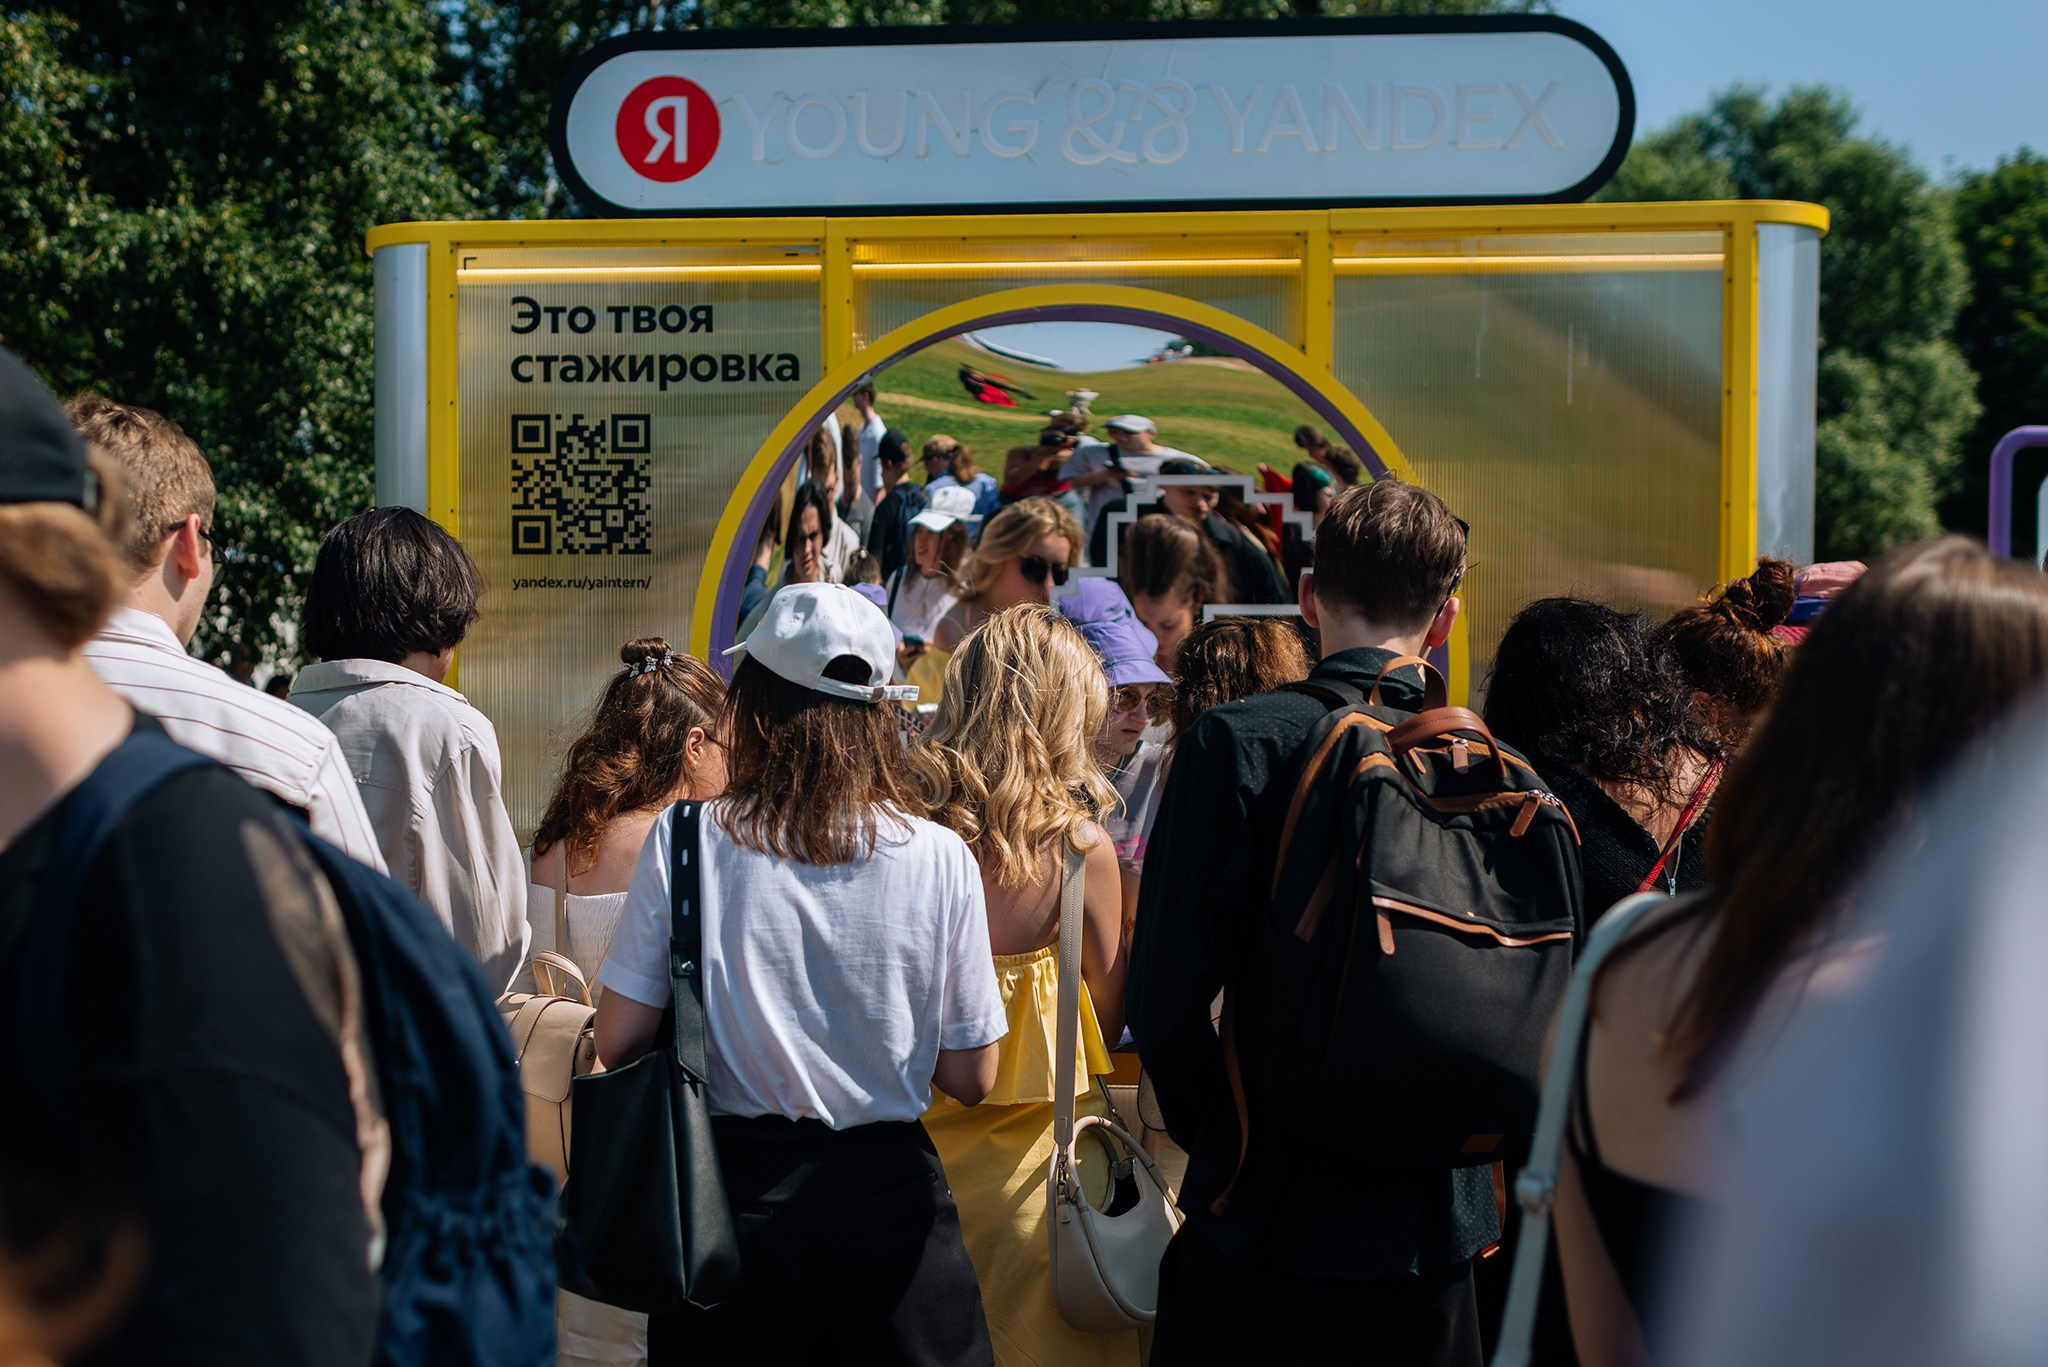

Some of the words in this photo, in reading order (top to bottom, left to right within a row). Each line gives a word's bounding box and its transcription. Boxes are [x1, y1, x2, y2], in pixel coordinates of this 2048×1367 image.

[643, 96, 688, 164] Я
[731, 90, 1041, 161] YOUNG
[1211, 80, 1565, 154] YANDEX
[511, 296, 597, 334] Это
[606, 304, 714, 333] твоя
[511, 353, 801, 391] стажировка
[512, 575, 652, 591] yandex.ru/yaintern/
